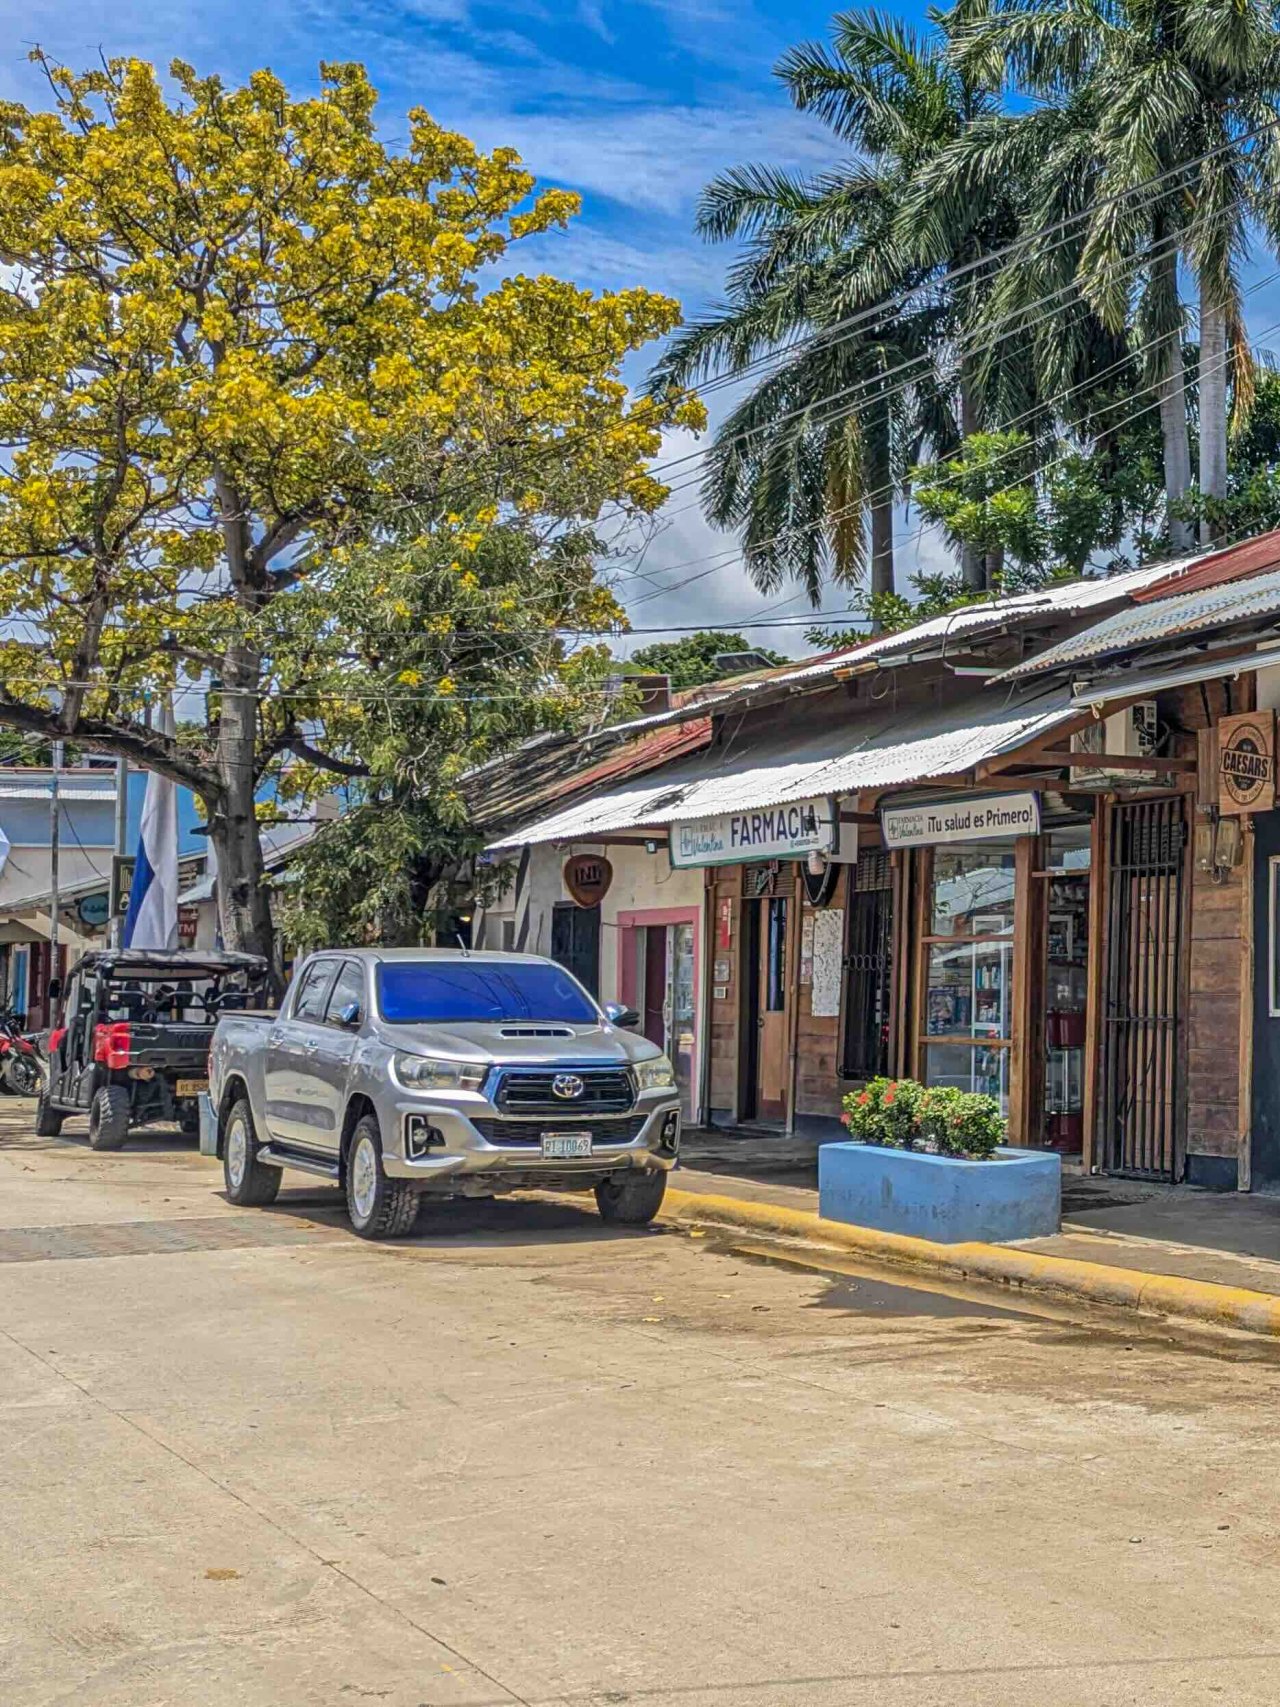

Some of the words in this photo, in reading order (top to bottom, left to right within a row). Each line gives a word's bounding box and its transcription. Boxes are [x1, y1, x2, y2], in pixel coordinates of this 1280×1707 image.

[1223, 751, 1269, 778] CAESARS
[730, 804, 818, 848] FARMACIA
[945, 810, 971, 832] salud
[973, 816, 984, 828] es
[987, 804, 1033, 826] Primero!
